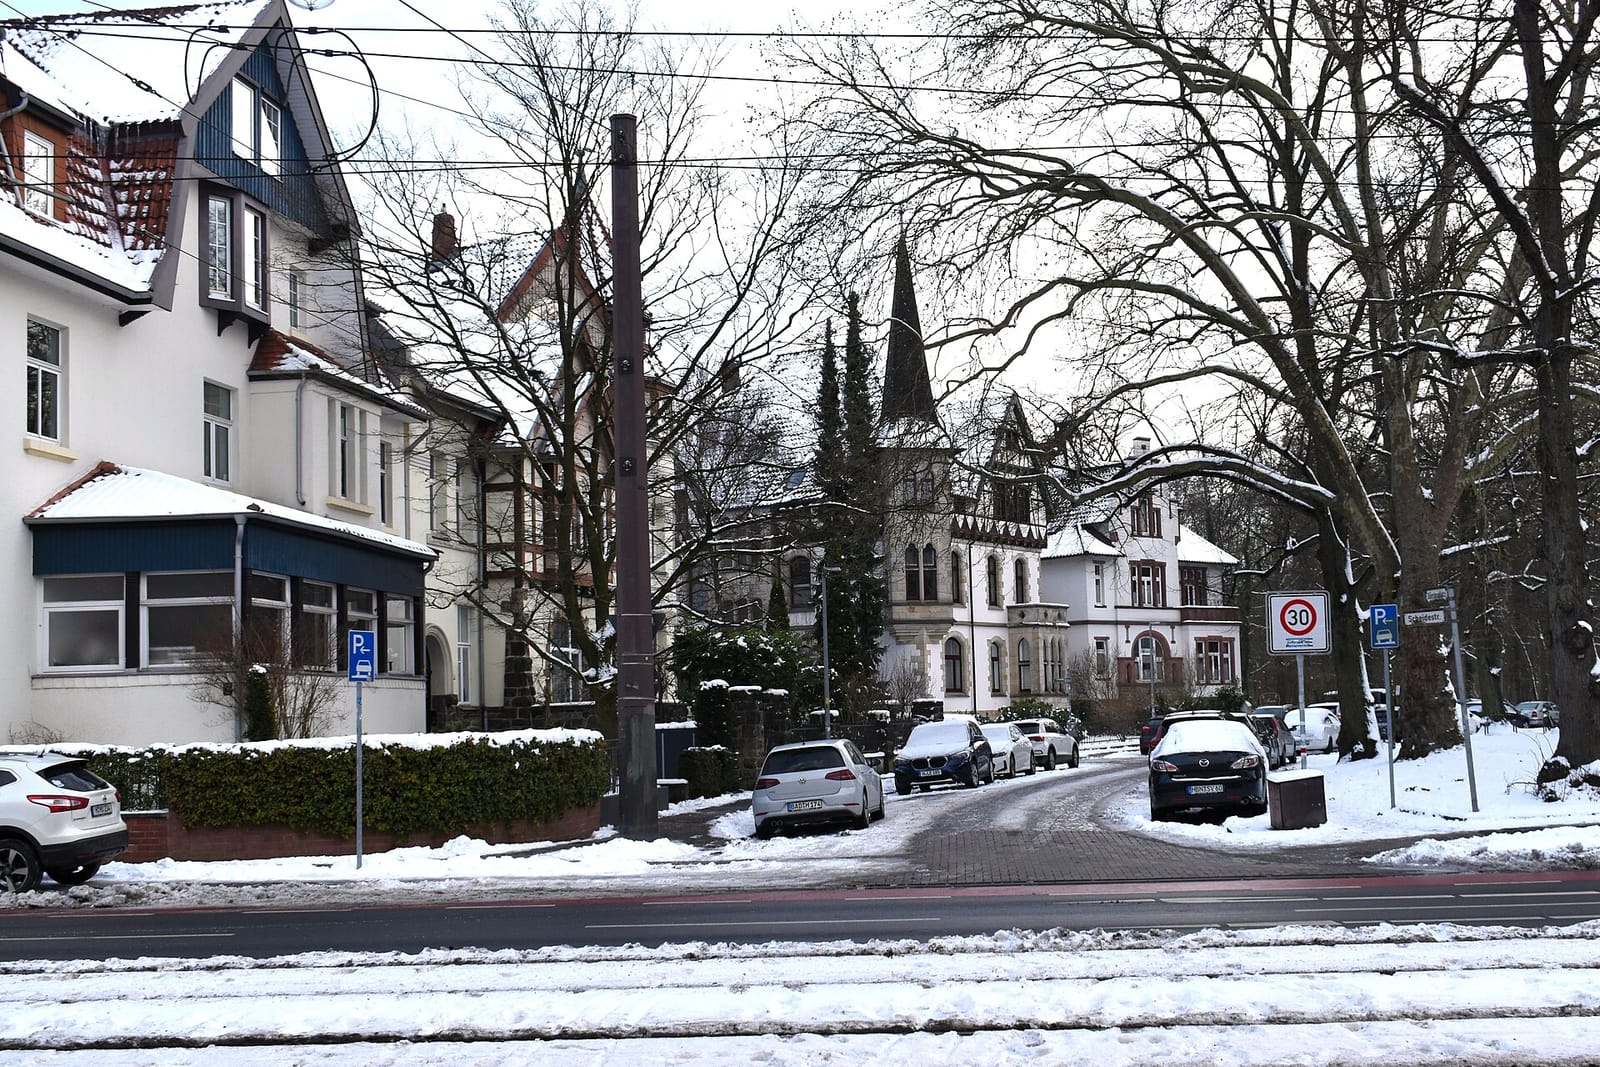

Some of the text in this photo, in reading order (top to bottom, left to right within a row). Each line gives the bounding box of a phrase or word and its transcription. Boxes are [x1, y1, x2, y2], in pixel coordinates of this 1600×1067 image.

[1287, 609, 1309, 626] 30
[1374, 608, 1386, 625] P
[353, 634, 364, 654] P
